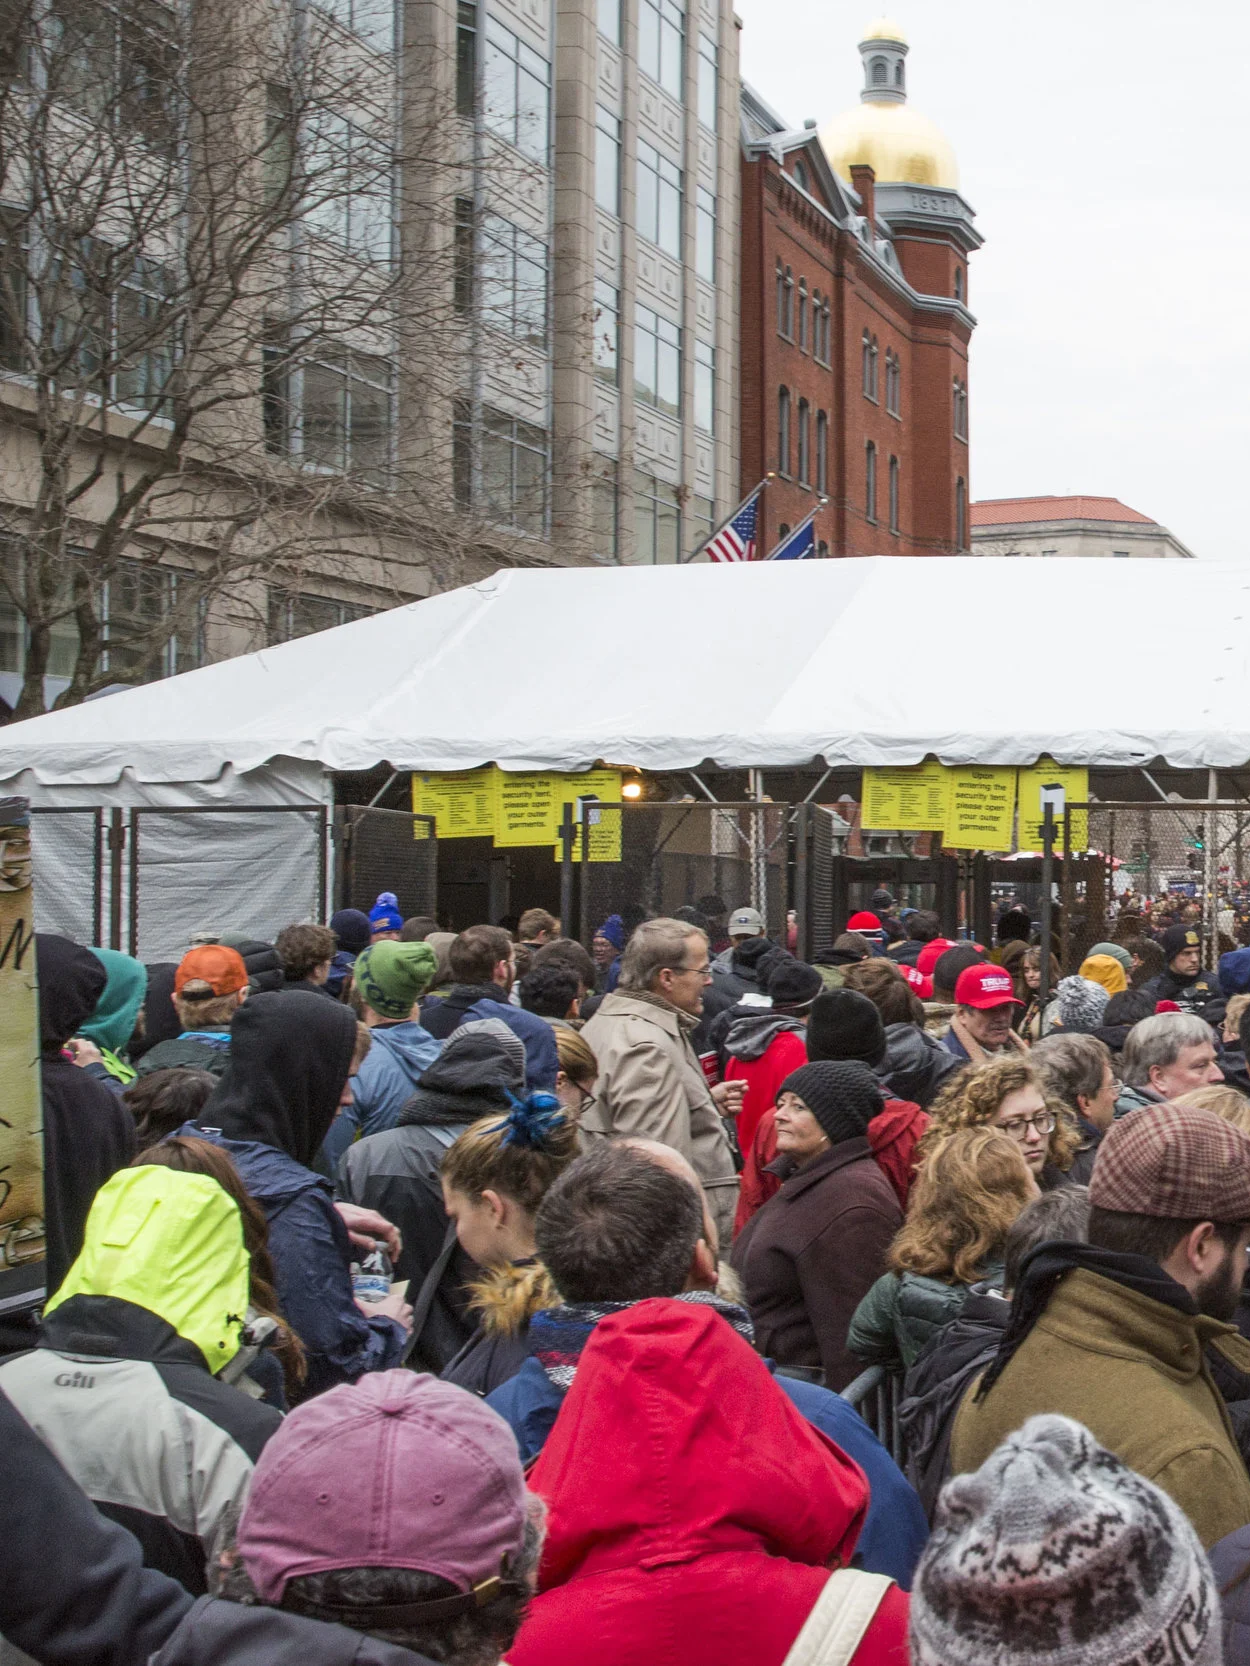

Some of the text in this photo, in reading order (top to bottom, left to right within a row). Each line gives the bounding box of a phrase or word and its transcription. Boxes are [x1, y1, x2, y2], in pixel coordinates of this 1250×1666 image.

[971, 771, 994, 780] Upon
[503, 781, 535, 789] entering
[958, 781, 1007, 791] entering the
[502, 791, 532, 799] security
[955, 791, 987, 800] security
[956, 801, 1005, 812] please open
[959, 813, 977, 821] your
[980, 977, 1010, 987] TRUMP
[54, 1371, 96, 1389] Gill
